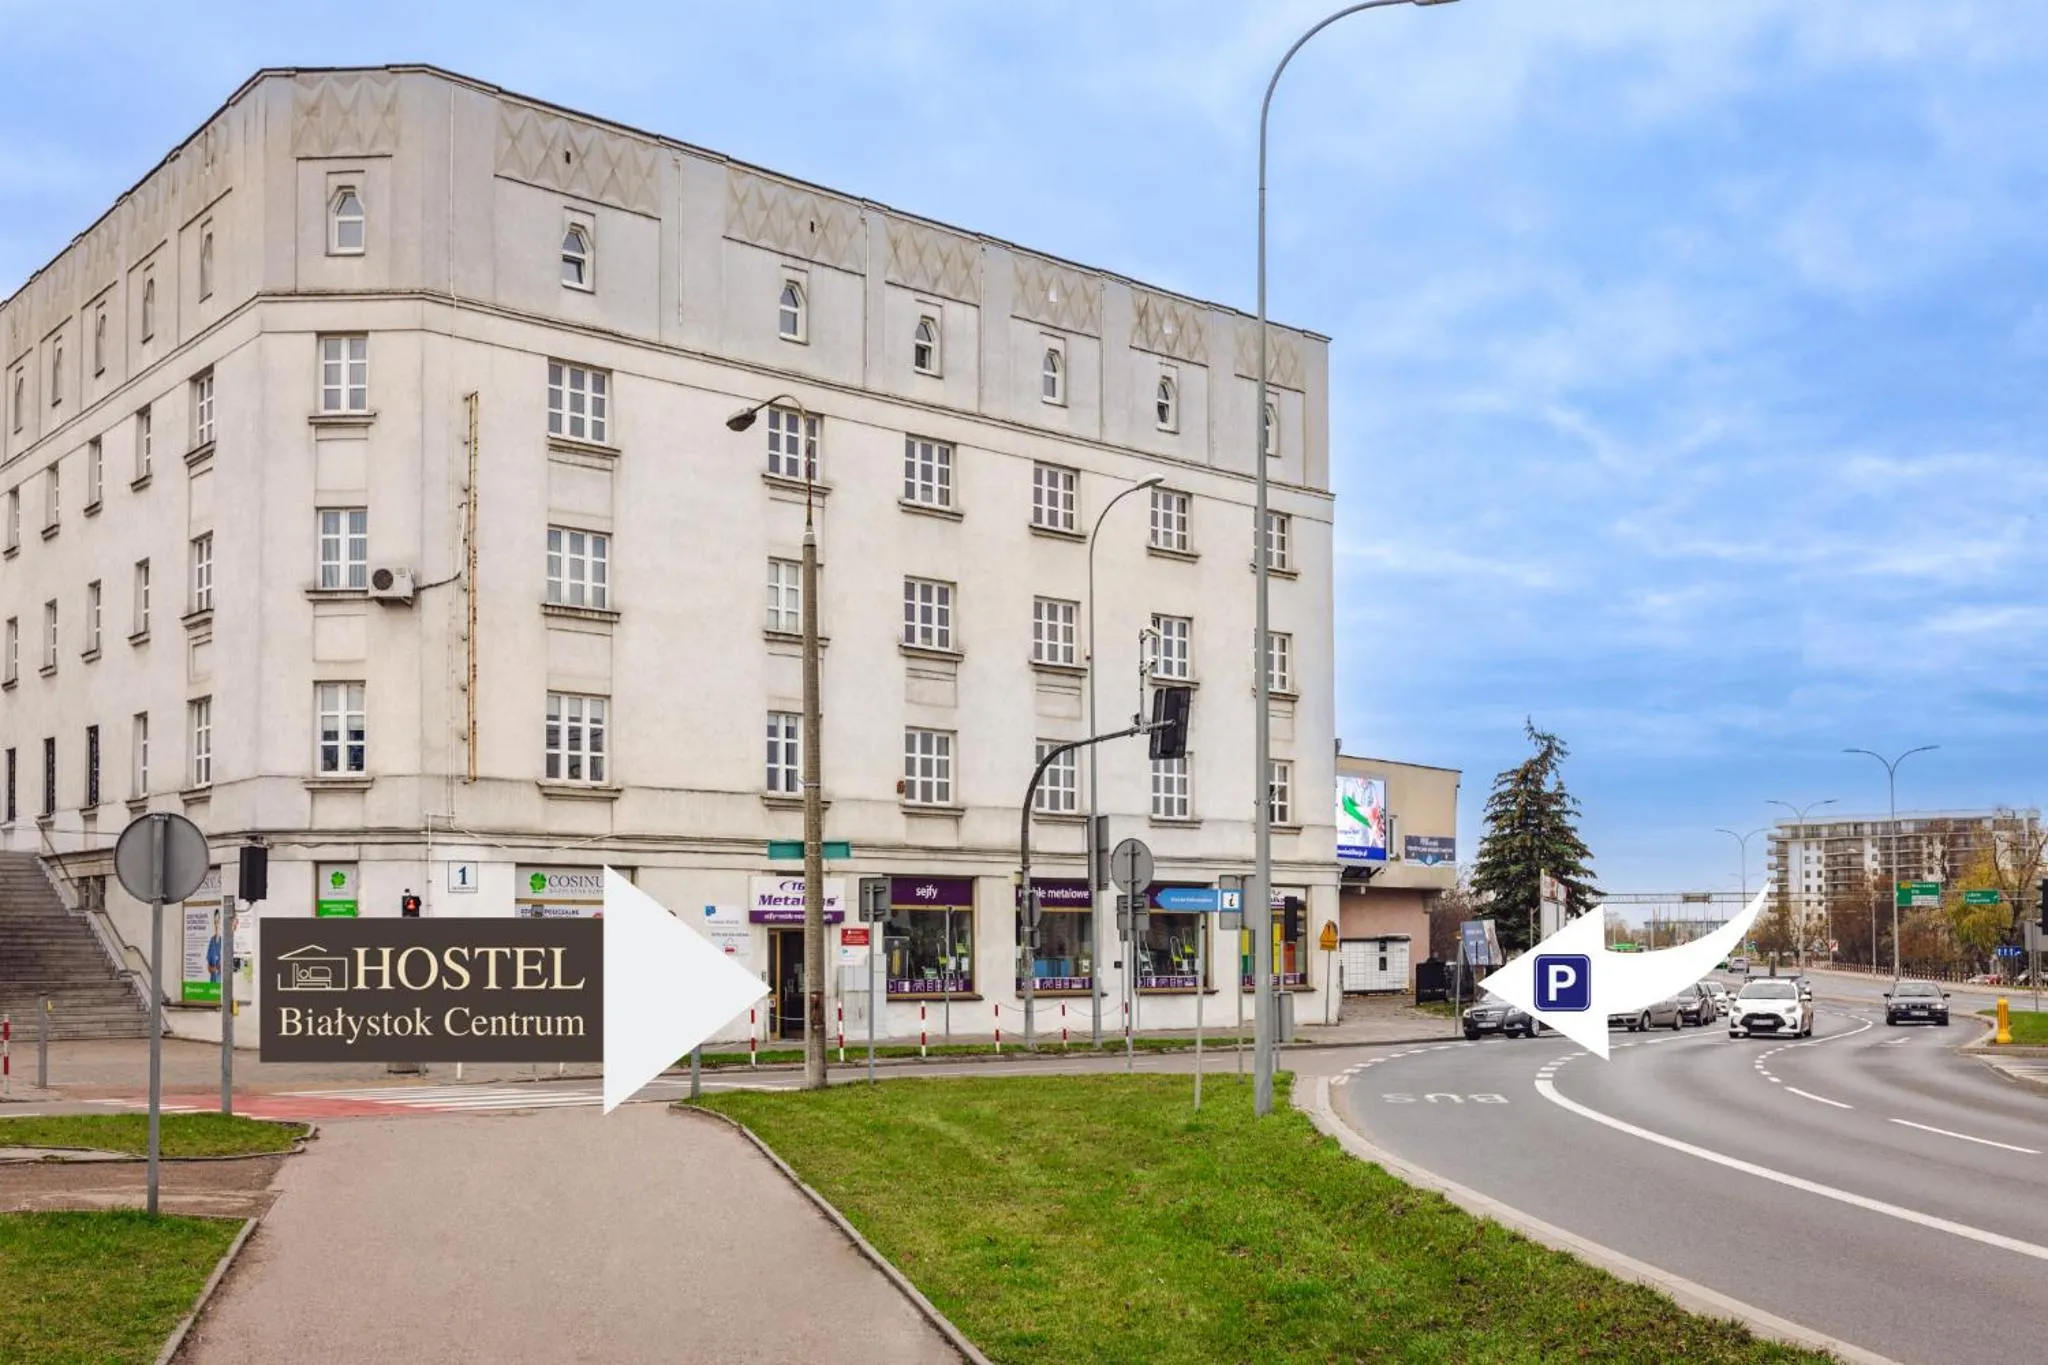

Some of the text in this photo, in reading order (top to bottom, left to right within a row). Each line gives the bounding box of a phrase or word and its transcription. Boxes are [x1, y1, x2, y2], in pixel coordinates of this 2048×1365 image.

[457, 865, 467, 885] 1
[548, 875, 604, 891] COSINU
[758, 894, 836, 906] Metals
[915, 884, 938, 900] sejfy
[1048, 887, 1090, 899] metalowe
